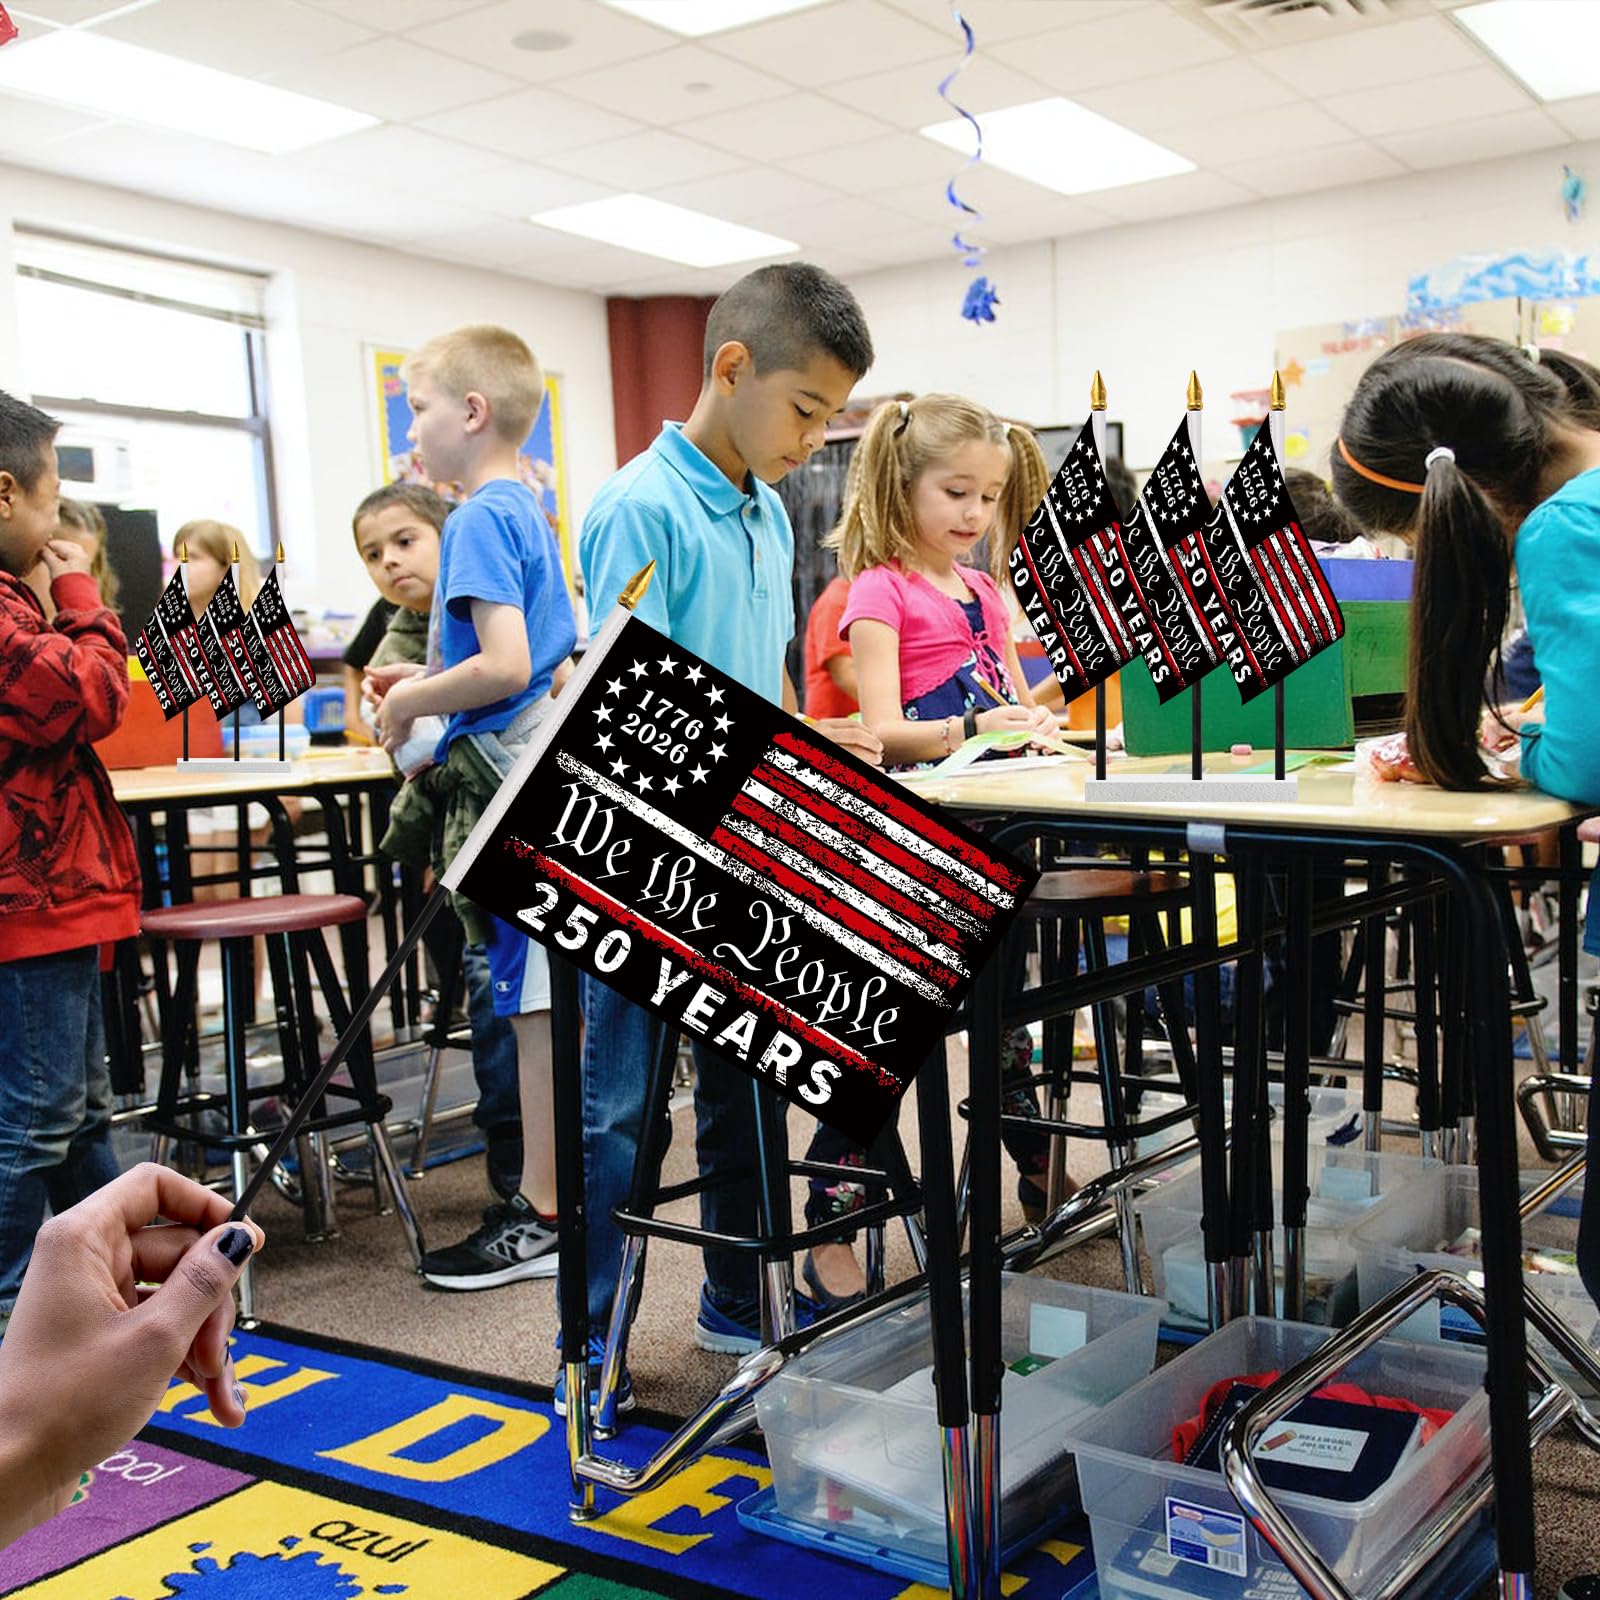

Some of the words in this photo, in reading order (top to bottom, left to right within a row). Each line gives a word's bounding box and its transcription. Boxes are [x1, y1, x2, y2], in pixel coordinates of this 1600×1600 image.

[1061, 466, 1080, 508] 2026
[1071, 459, 1090, 500] 1776
[1157, 466, 1176, 508] 2026
[1167, 459, 1186, 500] 1776
[1239, 466, 1258, 508] 2026
[1249, 459, 1268, 500] 1776
[1009, 546, 1030, 587] 50
[1025, 592, 1074, 683] YEARS
[1037, 545, 1065, 591] the
[1053, 588, 1106, 670] People
[1104, 546, 1125, 587] 50
[1121, 592, 1170, 683] YEARS
[1133, 545, 1160, 591] the
[1149, 588, 1202, 670] People
[1186, 546, 1207, 587] 50
[1203, 592, 1252, 683] YEARS
[1215, 545, 1243, 591] the
[1230, 588, 1284, 670] People
[136, 636, 147, 658] 50
[144, 660, 171, 710] YEARS
[186, 636, 199, 658] 50
[196, 660, 222, 710] YEARS
[230, 636, 243, 658] 50
[240, 660, 267, 710] YEARS
[619, 714, 689, 766] 2026
[639, 689, 705, 741] 1776
[545, 780, 633, 879] We
[637, 850, 719, 934] the
[713, 900, 899, 1048] People
[515, 881, 630, 973] 250
[647, 959, 843, 1106] YEARS
[158, 1354, 342, 1429] H
[314, 1393, 551, 1483] D
[97, 1448, 187, 1487] bol
[309, 1519, 431, 1563] azul
